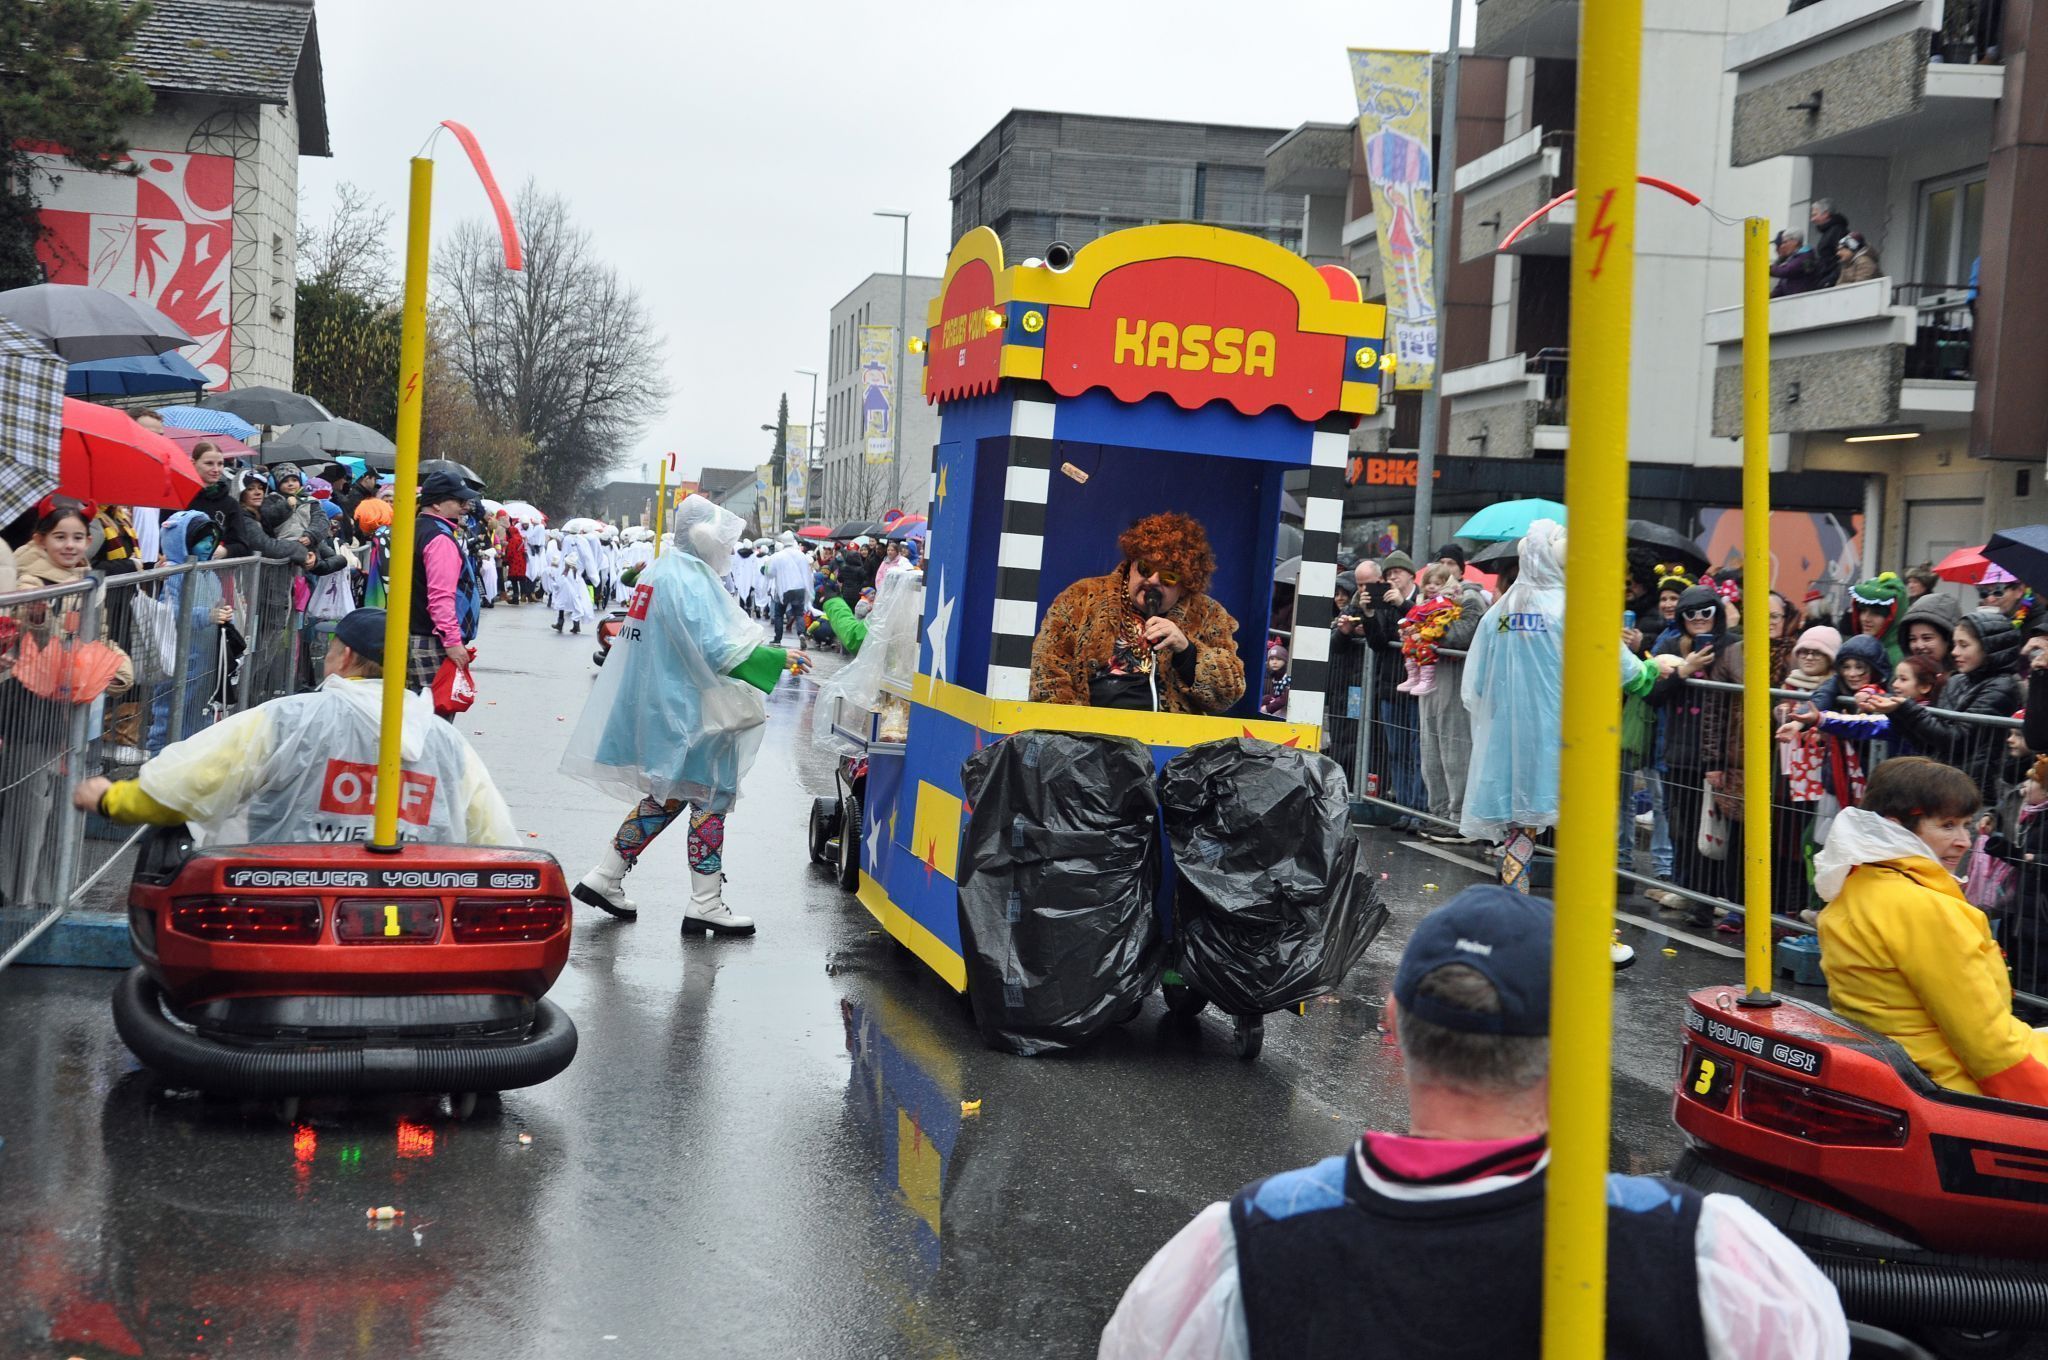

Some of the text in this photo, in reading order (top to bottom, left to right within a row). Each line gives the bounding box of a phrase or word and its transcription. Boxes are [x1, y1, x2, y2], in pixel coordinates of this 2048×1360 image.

[1113, 317, 1276, 378] KASSA
[1366, 458, 1440, 486] BIK
[382, 871, 479, 888] YOUNG
[384, 905, 400, 937] 1
[1707, 1019, 1765, 1055] YOUNG
[1694, 1058, 1716, 1095] 3
